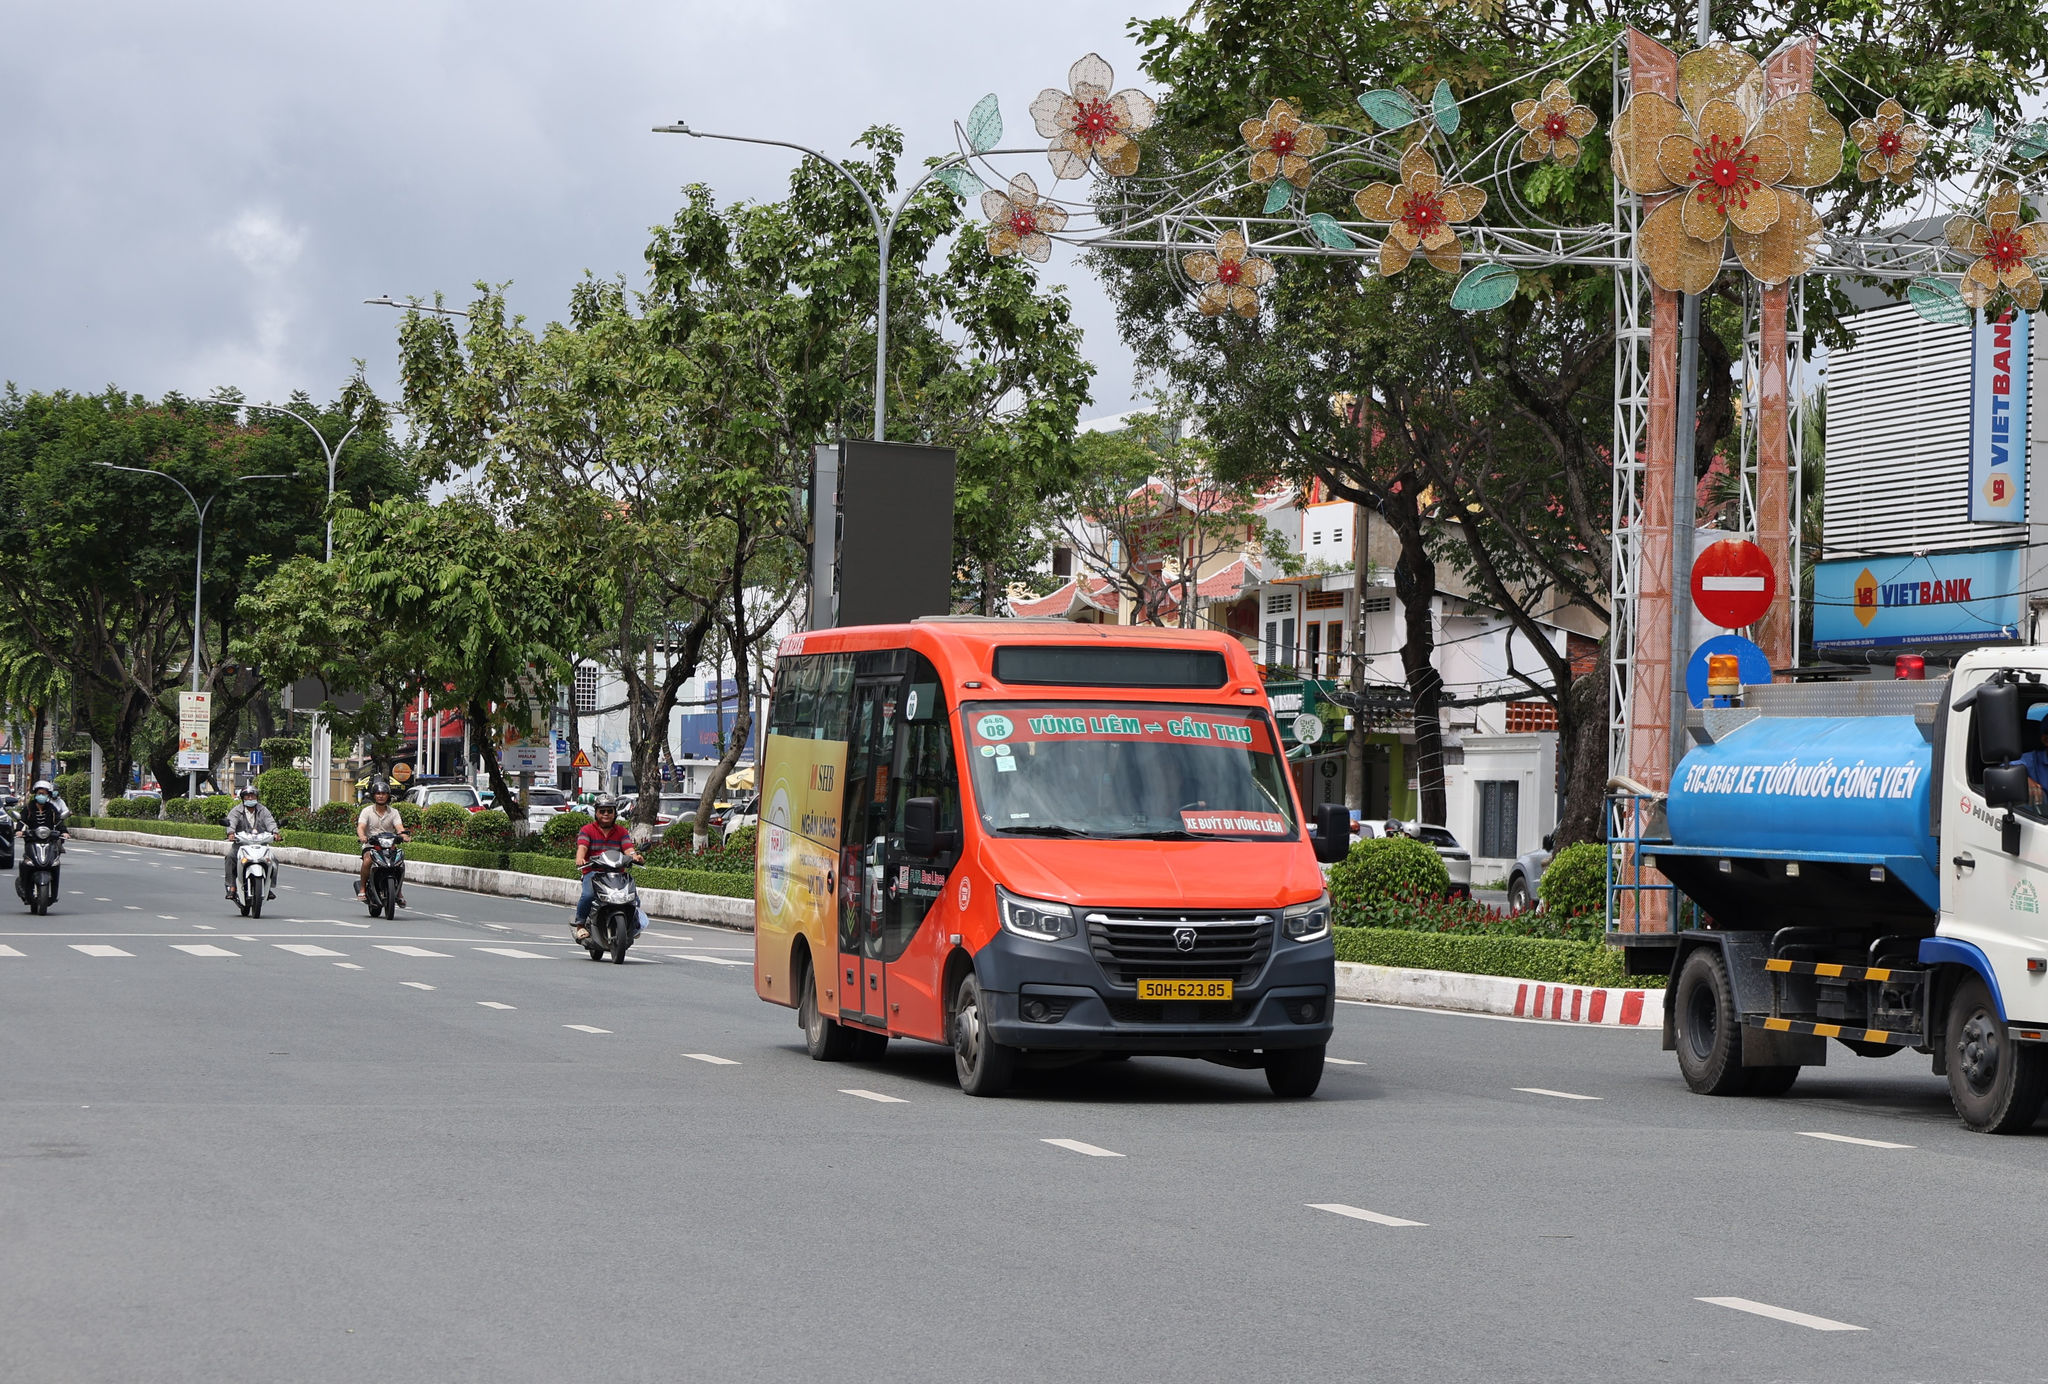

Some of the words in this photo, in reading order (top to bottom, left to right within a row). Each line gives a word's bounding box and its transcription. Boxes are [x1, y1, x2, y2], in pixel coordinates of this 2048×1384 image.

[1882, 578, 1972, 608] VIETBANK
[986, 725, 1006, 737] 08
[1028, 715, 1087, 735] VŨNG
[1089, 714, 1141, 734] LIÊM
[1167, 716, 1211, 739] CẦN
[1212, 723, 1253, 743] THƠ
[818, 764, 835, 793] SHB
[1734, 764, 1762, 794] XE
[1757, 758, 1799, 796] TƯỚI
[1790, 758, 1837, 798] NƯỚC
[1833, 760, 1881, 799] CÔNG
[1879, 760, 1922, 799] VIÊN
[1185, 817, 1198, 830] XE
[1198, 816, 1224, 830] BUÝT
[1223, 818, 1235, 830] ĐI
[1234, 816, 1261, 831] VŨNG
[1260, 819, 1284, 833] LIÊM
[1146, 983, 1225, 997] 50H-623.85
